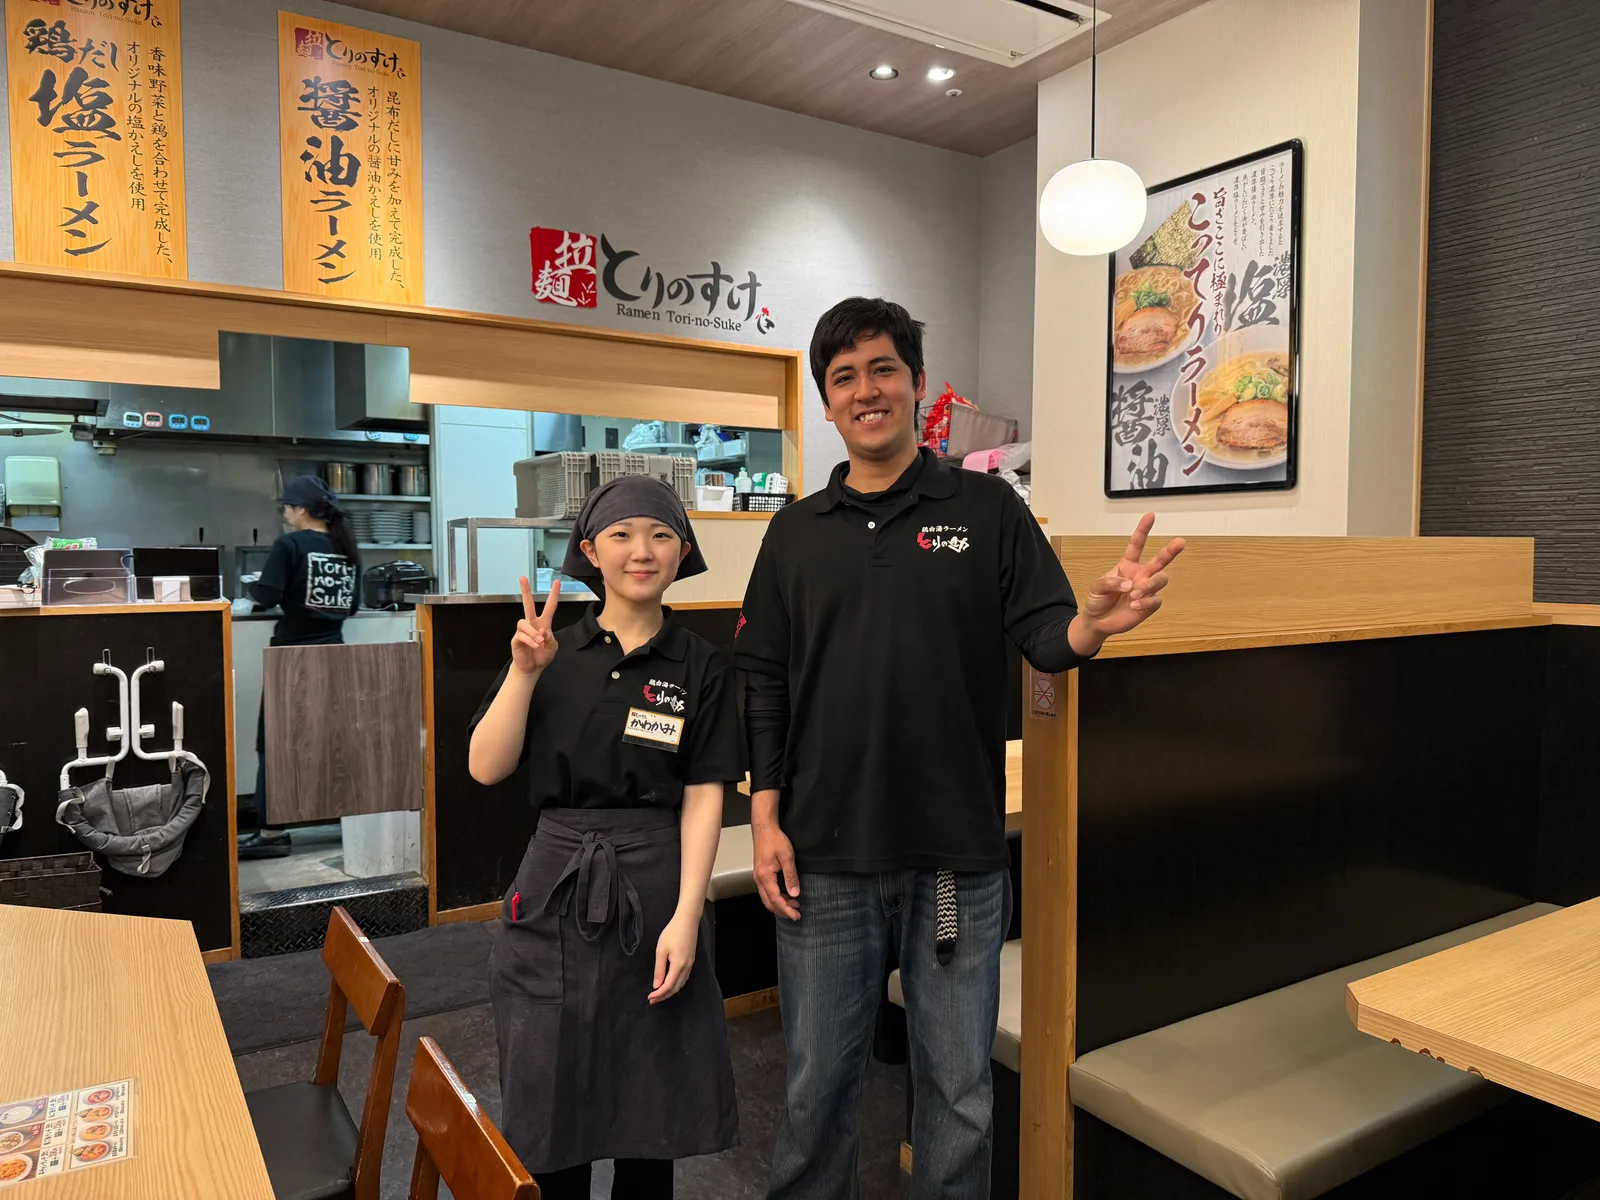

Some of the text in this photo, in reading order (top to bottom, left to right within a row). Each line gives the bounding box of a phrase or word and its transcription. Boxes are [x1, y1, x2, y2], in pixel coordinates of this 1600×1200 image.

[23, 19, 119, 71] 鶏だし
[324, 32, 399, 73] とりのすけ
[28, 66, 122, 257] 塩ラーメン
[126, 41, 146, 212] オリジナルの塩かえしを使用
[148, 47, 173, 263] 香味野菜と鶏を合わせて完成した、
[297, 75, 362, 285] 醤油ラーメン
[366, 86, 383, 260] オリジナルの醤油かえしを使用
[601, 233, 762, 322] とりのすけ
[616, 303, 742, 332] Ramen Tori-no-Suke
[1210, 187, 1227, 337] 旨さここに極まれり
[1223, 259, 1281, 332] 塩
[1181, 192, 1213, 477] こってりラーメン
[1111, 380, 1169, 490] 醤油
[311, 587, 353, 607] Suke
